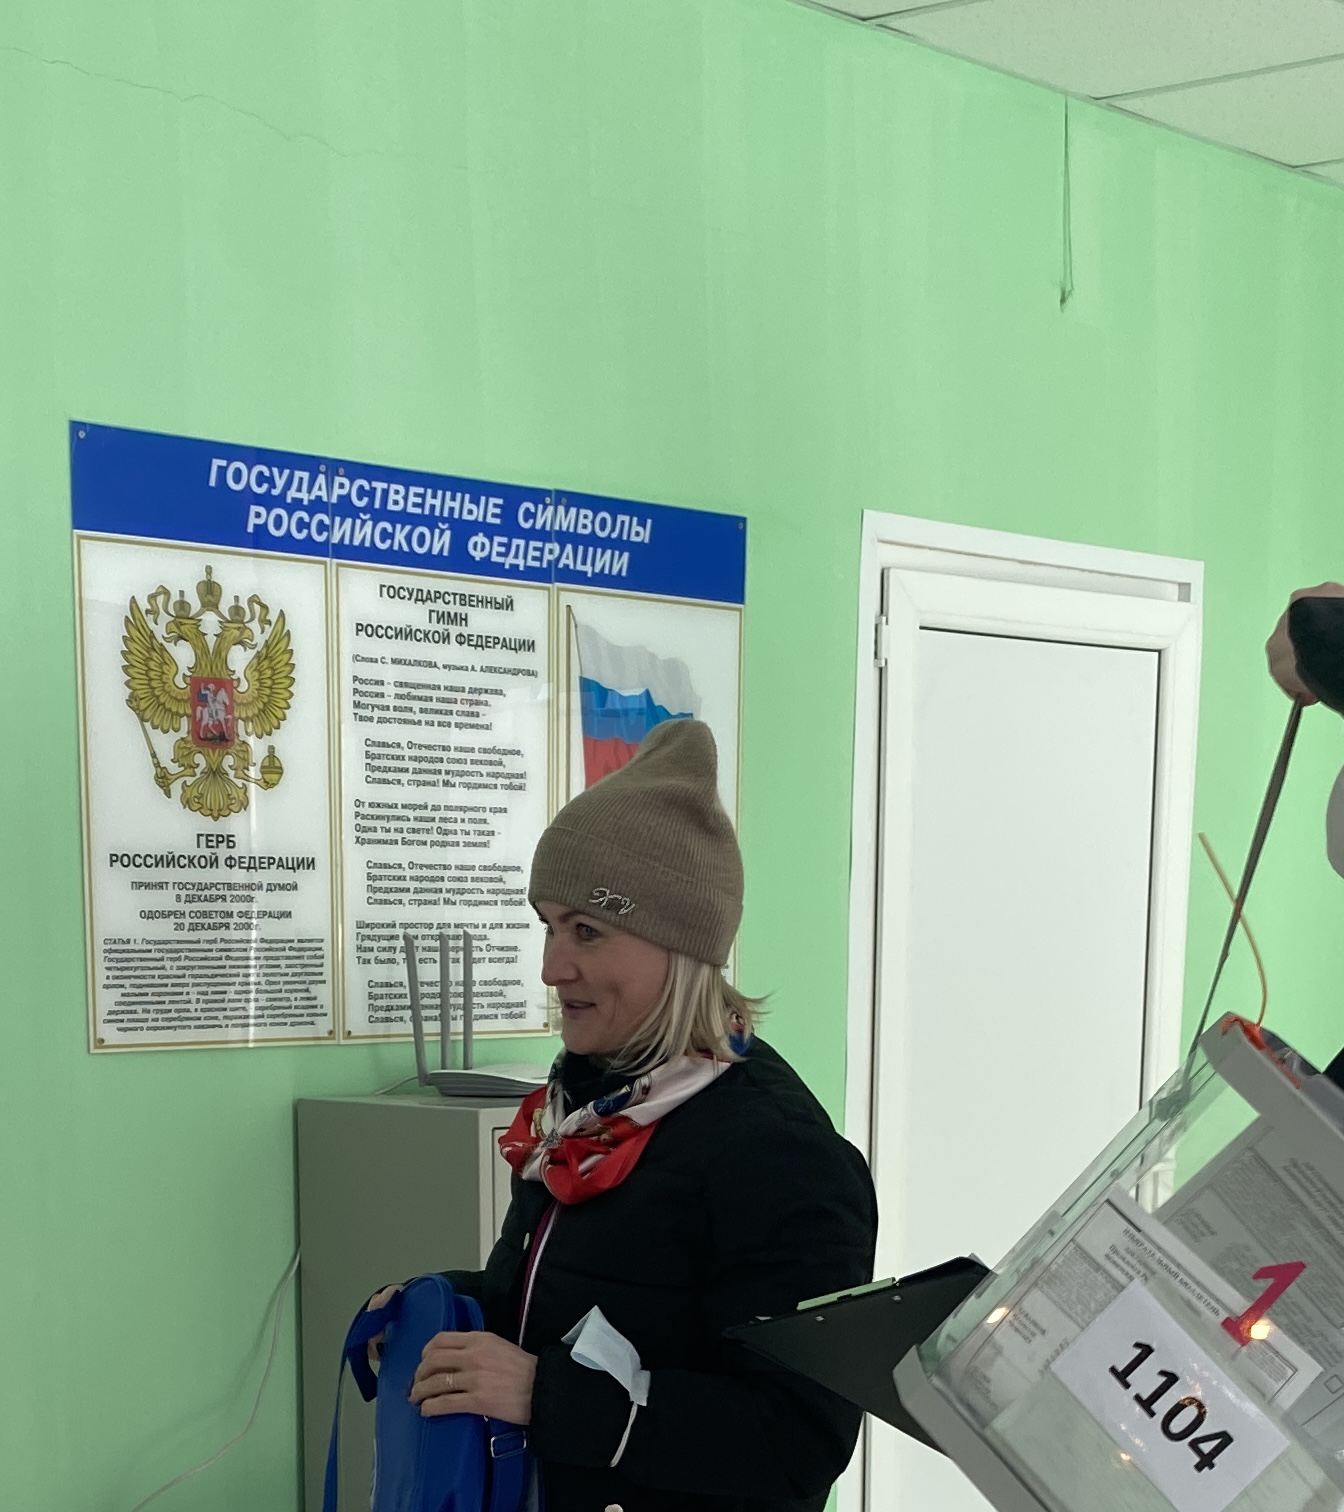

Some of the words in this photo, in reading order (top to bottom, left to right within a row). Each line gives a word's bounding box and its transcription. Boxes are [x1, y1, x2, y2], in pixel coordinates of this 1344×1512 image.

[209, 458, 503, 524] ГОСУДАРСТВЕННЫЕ
[518, 501, 652, 544] СИМВОЛЫ
[247, 505, 451, 556] РОССИЙСКОЙ
[468, 533, 630, 577] ФЕДЕРАЦИИ
[379, 584, 514, 611] ГОСУДАРСТВЕННЫЙ
[428, 610, 468, 627] ГИМН
[355, 623, 450, 645] РОССИЙСКОЙ
[455, 632, 535, 653] ФЕДЕРАЦИИ
[352, 654, 378, 664] (Слова
[471, 664, 477, 672] А.
[353, 675, 384, 686] Россия
[394, 681, 441, 691] священная
[444, 684, 465, 693] наша
[468, 687, 506, 697] держава,
[353, 688, 385, 699] Россия
[394, 692, 433, 702] любимая
[436, 696, 457, 704] наша
[460, 698, 491, 708] страна.
[353, 701, 390, 713] Могучая
[393, 705, 416, 715] воля,
[419, 707, 453, 716] великая
[456, 709, 480, 718] слава
[354, 713, 374, 723] Твое
[376, 716, 422, 727] достоянье
[425, 719, 434, 727] на
[437, 720, 451, 728] все
[455, 721, 492, 730] времена!
[364, 738, 404, 750] Славься,
[407, 741, 451, 752] Отечество
[454, 745, 475, 754] наше
[478, 746, 524, 757] свободное,
[365, 751, 405, 762] Братских
[408, 755, 444, 764] народов
[446, 757, 467, 765] союз
[470, 758, 506, 768] вековой,
[365, 763, 409, 774] Предками
[412, 767, 442, 776] данная
[445, 769, 483, 779] мудрость
[486, 771, 526, 781] народная!
[365, 775, 404, 787] Славься,
[407, 779, 439, 788] страна!
[442, 779, 455, 788] Мы
[458, 781, 497, 791] гордимся
[500, 782, 526, 791] тобой!
[354, 799, 365, 808] От
[368, 802, 398, 810] южных
[401, 802, 428, 812] морей
[431, 804, 441, 812] до
[444, 805, 486, 814] полярного
[489, 806, 507, 815] края
[355, 812, 410, 823] Раскинулись
[413, 815, 436, 823] наши
[438, 815, 458, 824] леса
[468, 817, 489, 825] поля.
[355, 823, 377, 834] Одна
[380, 826, 391, 834] ты
[394, 826, 404, 834] на
[406, 826, 433, 835] свете!
[436, 826, 457, 837] Одна
[473, 829, 494, 837] такая
[196, 833, 236, 848] ГЕРБ
[355, 836, 398, 847] Хранимая
[401, 837, 427, 847] Богом
[430, 839, 460, 849] родная
[462, 840, 490, 849] земля!
[109, 851, 219, 869] РОССИЙСКОЙ
[225, 855, 316, 872] ФЕДЕРАЦИИ
[366, 860, 405, 871] Славься,
[408, 861, 452, 871] Отечество
[455, 863, 476, 871] наше
[478, 863, 523, 873] свободное,
[367, 872, 407, 883] Братских
[409, 874, 445, 883] народов
[131, 882, 169, 890] ПРИНЯТ
[173, 881, 263, 892] ГОСУДАРСТВЕННОЙ
[266, 882, 298, 892] ДУМОЙ
[367, 884, 410, 894] Предками
[413, 887, 443, 895] данная
[445, 887, 484, 896] мудрость
[176, 894, 181, 903] 8
[184, 894, 226, 904] ДЕКАБРЯ
[367, 896, 405, 906] Славься,
[408, 897, 440, 907] страна!
[443, 897, 457, 906] Мы
[459, 899, 498, 908] гордимся
[501, 898, 526, 907] тобой!
[139, 910, 186, 920] ОДОБРЕН
[189, 910, 234, 919] СОВЕТОМ
[237, 910, 292, 920] ФЕДЕРАЦИИ
[174, 923, 185, 931] 20
[188, 923, 230, 932] ДЕКАБРЯ
[356, 920, 396, 930] Широкий
[399, 922, 434, 931] простор
[436, 922, 451, 930] для
[489, 922, 503, 930] для
[356, 932, 400, 943] Грядущие
[356, 945, 374, 953] Нам
[377, 945, 397, 955] силу
[357, 956, 371, 965] Так
[374, 955, 400, 965] было,
[489, 954, 518, 964] всегда!
[368, 980, 406, 989] Славься,
[368, 991, 407, 1000] Братских
[368, 1015, 406, 1024] Славься,
[501, 1011, 526, 1020] тобой!
[1221, 1260, 1307, 1347] 1
[1108, 1340, 1235, 1474] 1104
